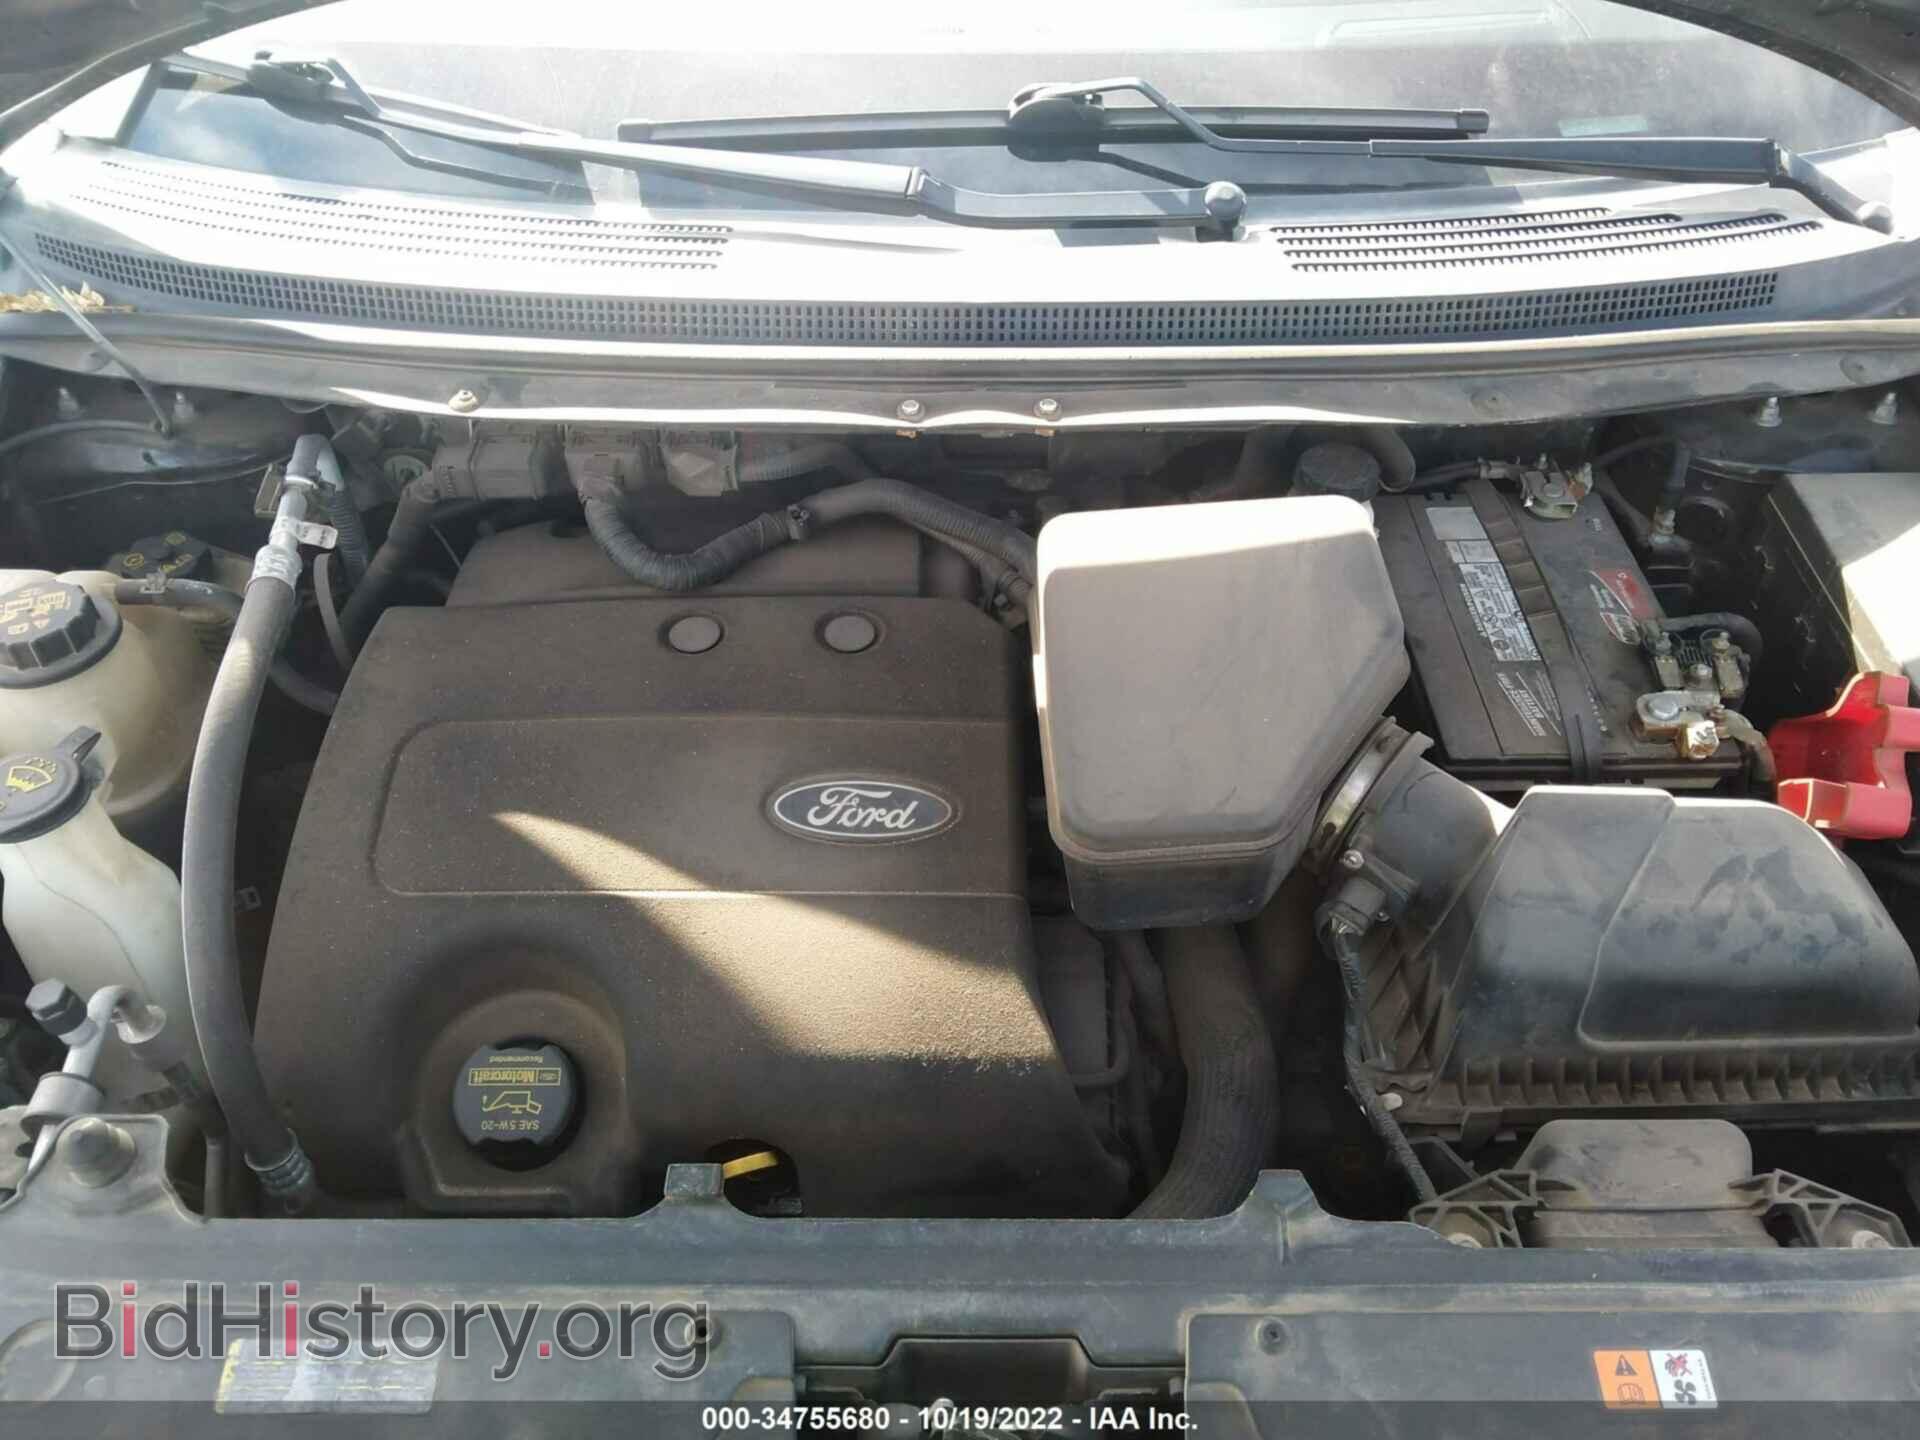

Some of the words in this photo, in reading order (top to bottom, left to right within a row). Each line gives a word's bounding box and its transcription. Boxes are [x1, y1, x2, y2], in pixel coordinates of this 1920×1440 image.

[807, 787, 919, 829] Ford
[474, 1070, 536, 1082] Motorcraft
[519, 1119, 541, 1130] SAE
